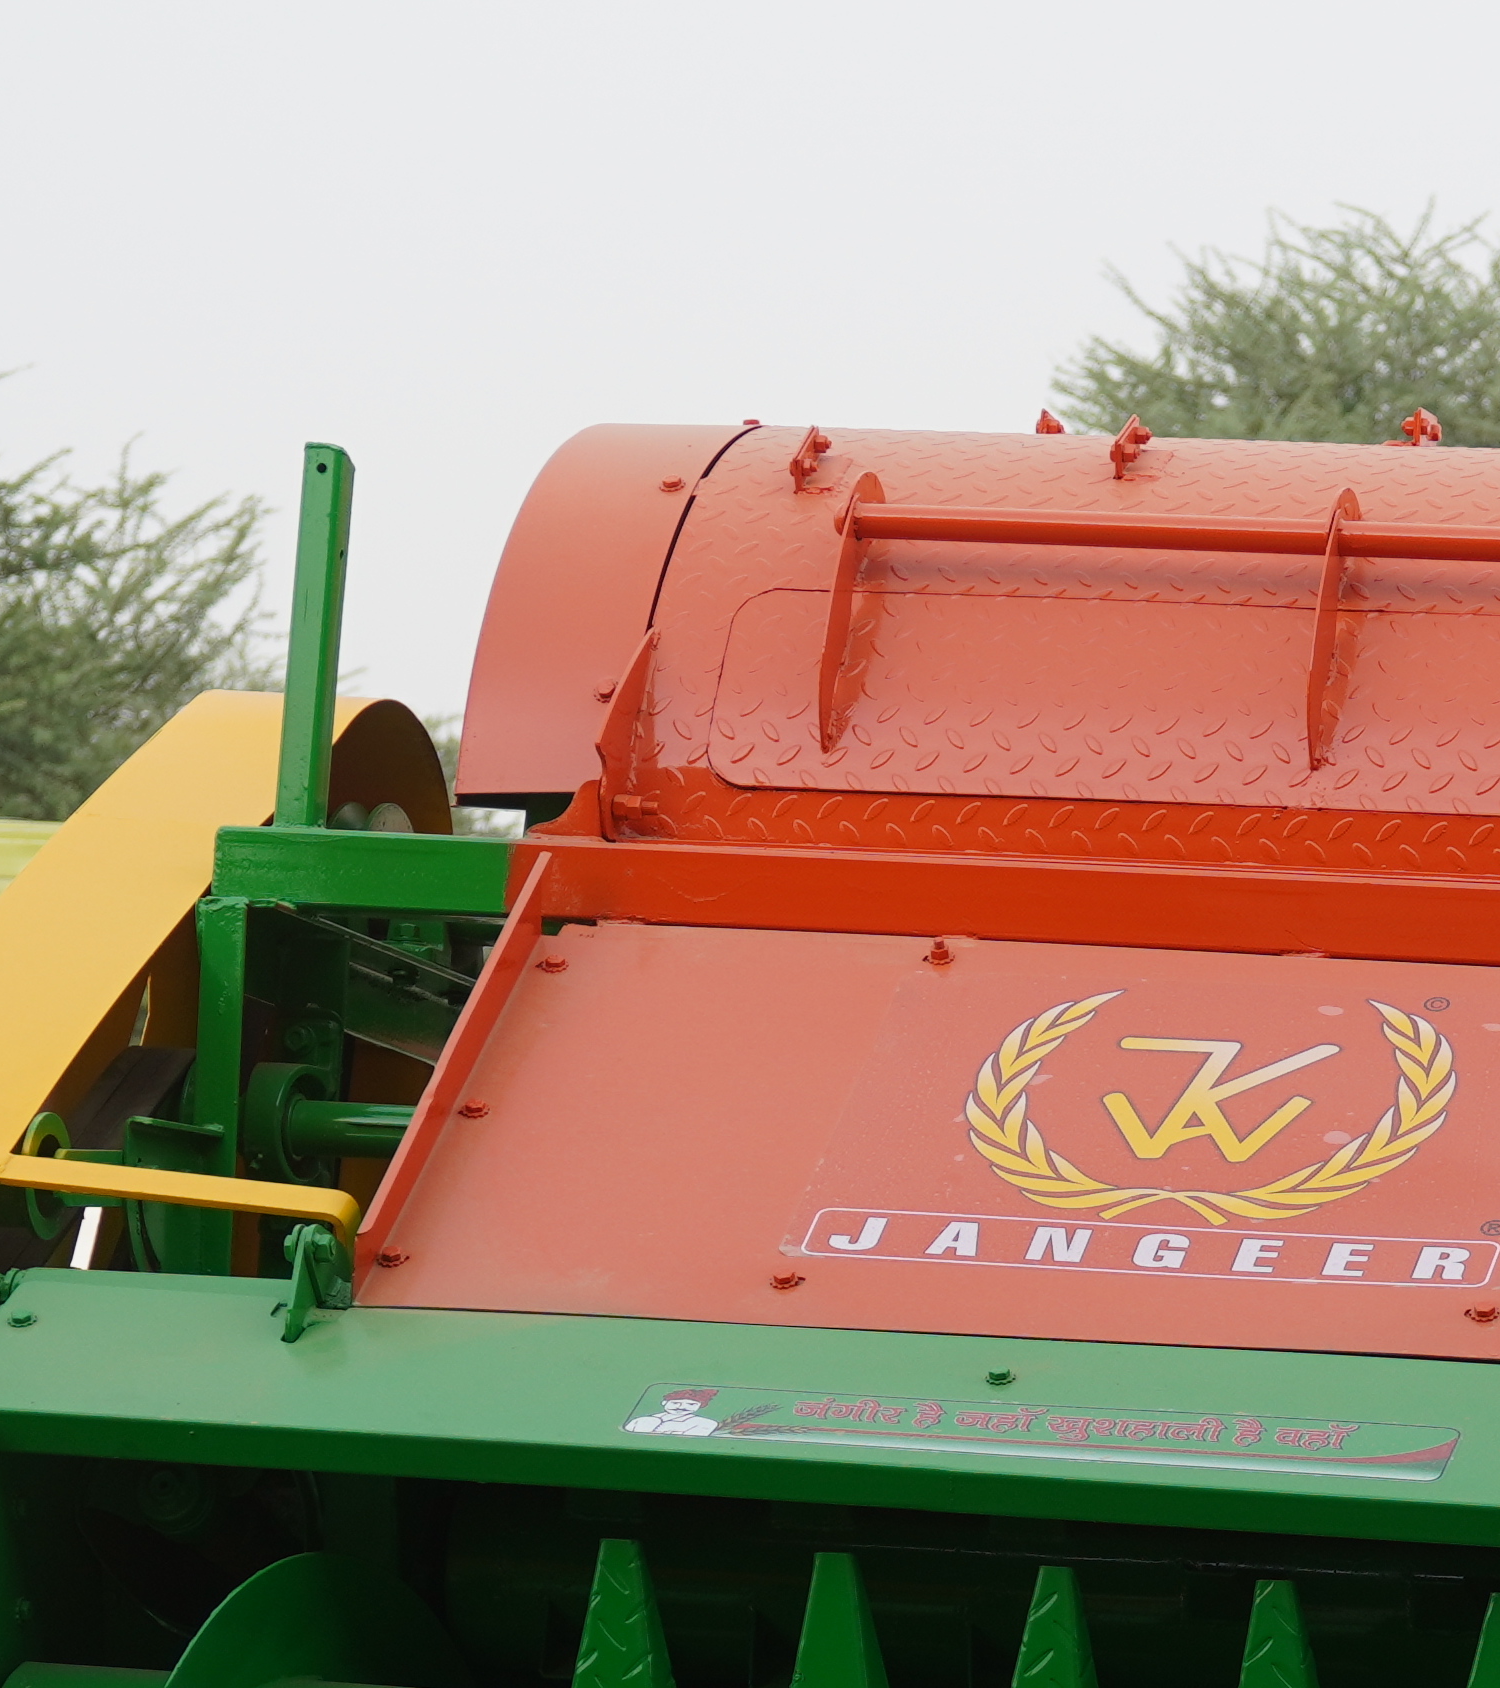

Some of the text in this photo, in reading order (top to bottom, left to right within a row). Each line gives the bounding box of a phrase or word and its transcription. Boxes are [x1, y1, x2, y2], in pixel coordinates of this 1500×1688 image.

[827, 1216, 1471, 1281] JANGEER
[792, 1397, 905, 1424] जंगीर
[912, 1401, 947, 1429] है
[1046, 1416, 1228, 1443] खुशहाली
[1232, 1417, 1266, 1447] है
